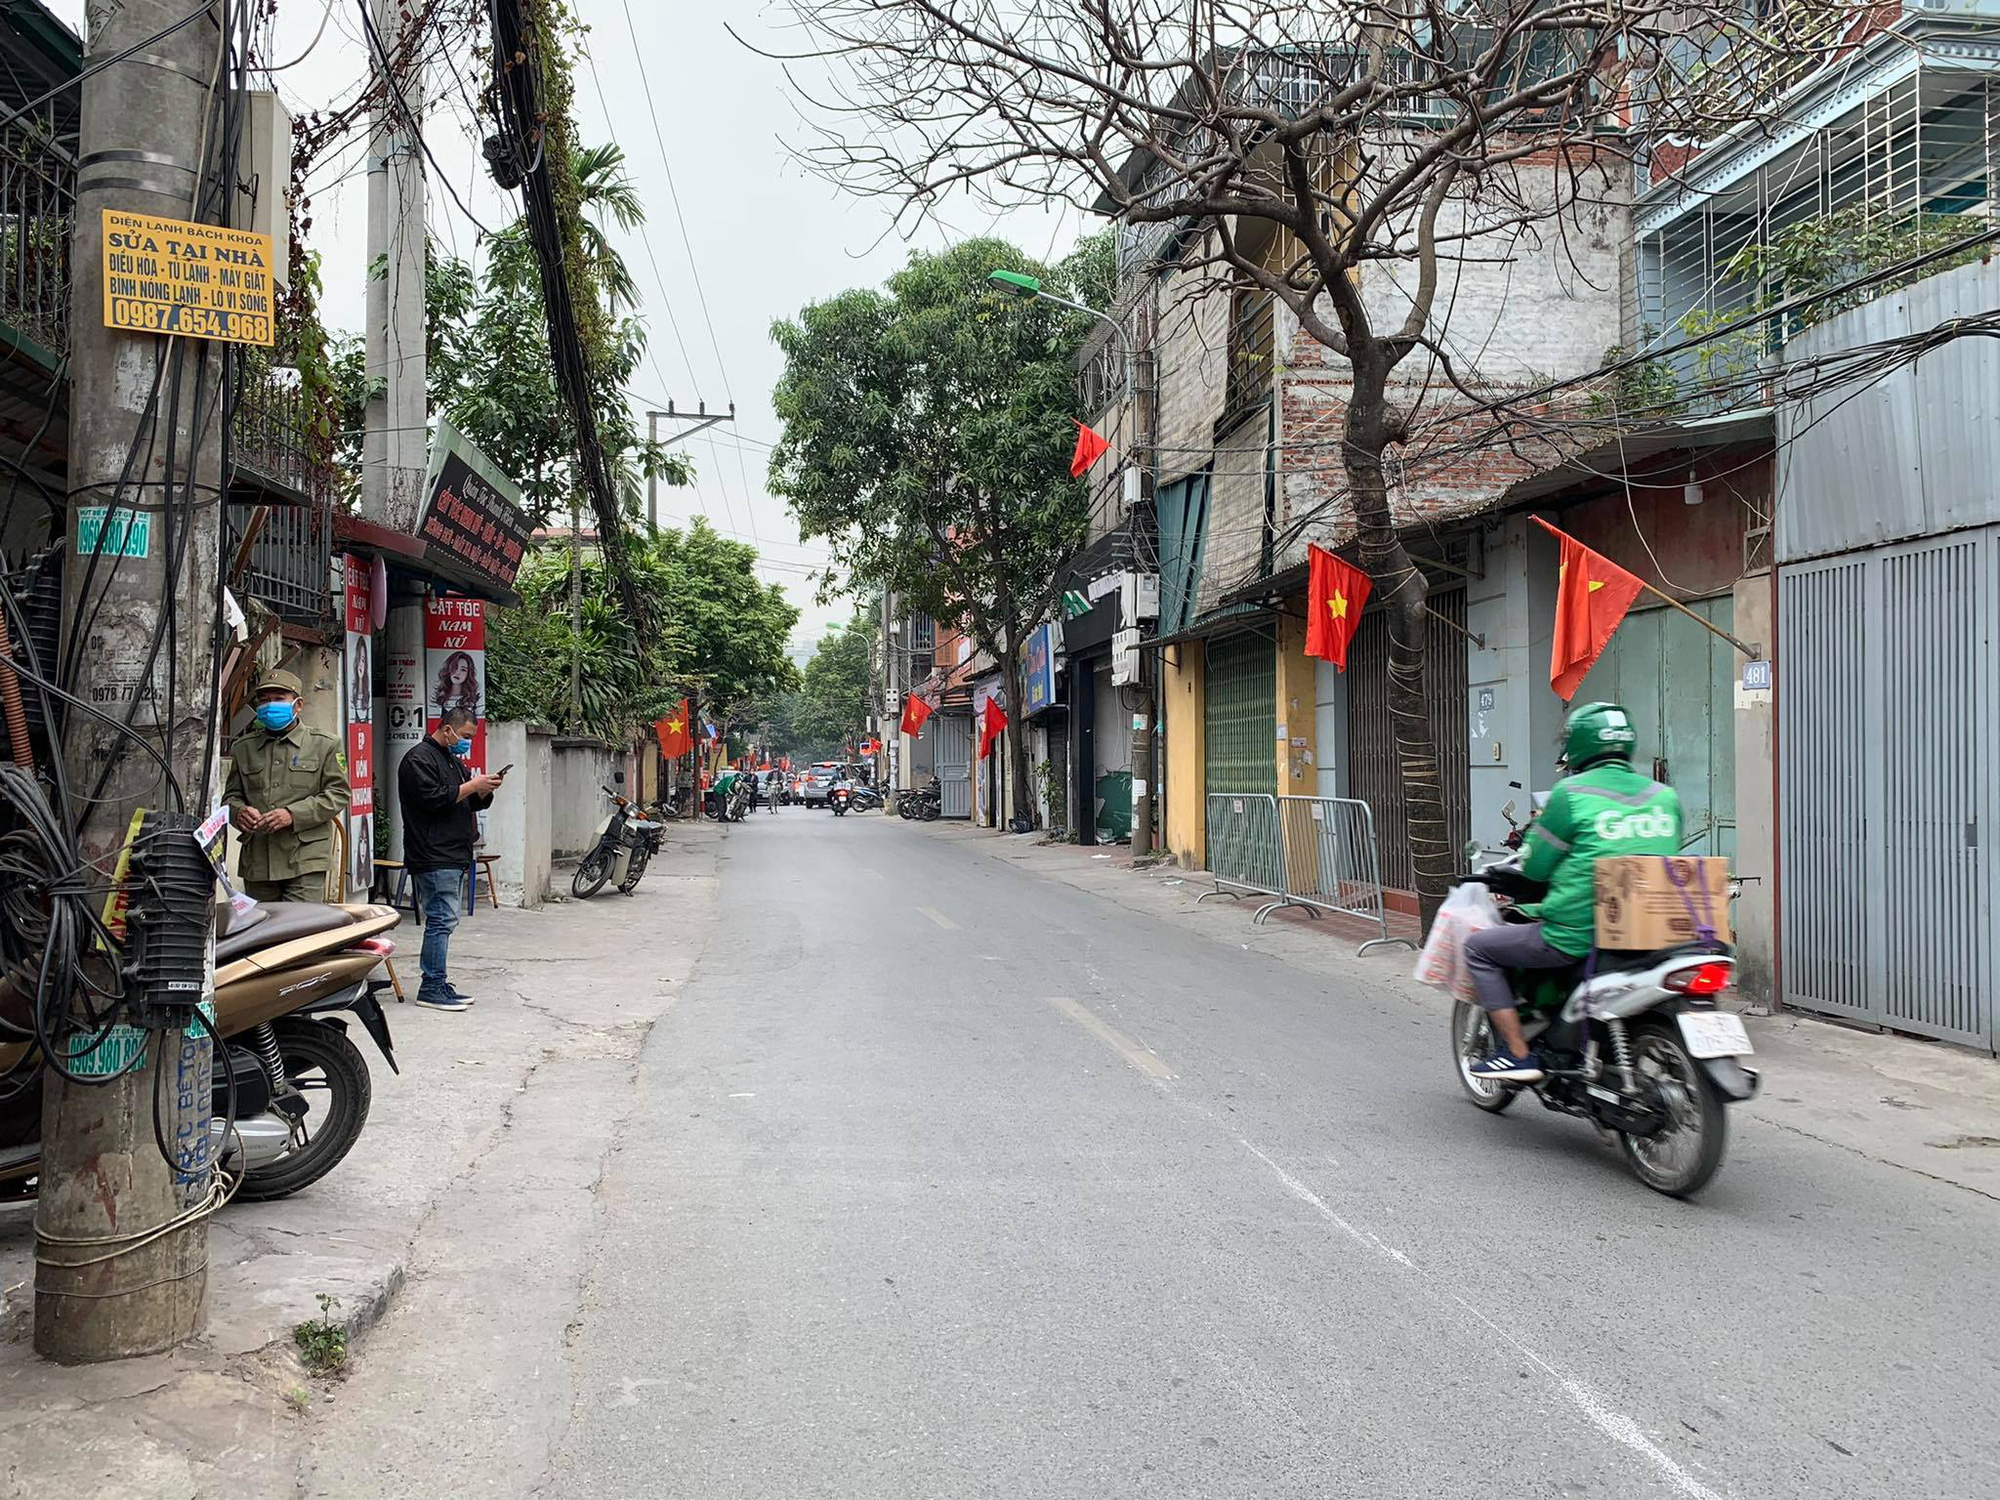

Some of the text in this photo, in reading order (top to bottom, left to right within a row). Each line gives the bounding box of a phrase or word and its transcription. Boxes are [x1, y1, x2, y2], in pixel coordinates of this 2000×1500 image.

[146, 221, 183, 234] LẠNH
[187, 225, 223, 241] BÁCH
[227, 233, 263, 246] KHOA
[108, 229, 159, 253] SỬA
[215, 248, 265, 268] NHÀ
[136, 253, 158, 277] HÒA
[219, 266, 241, 290] MÁY
[109, 274, 136, 297] BÌNH
[140, 278, 170, 302] NÓNG
[211, 287, 223, 308] LÒ
[227, 293, 237, 309] VI
[114, 299, 268, 342] 0987.654.968
[456, 599, 480, 617] TÓC
[438, 620, 472, 632] NAM
[444, 635, 468, 648] NỮ
[1746, 666, 1766, 684] 481
[92, 687, 117, 701] 0978
[1594, 805, 1674, 839] Grab
